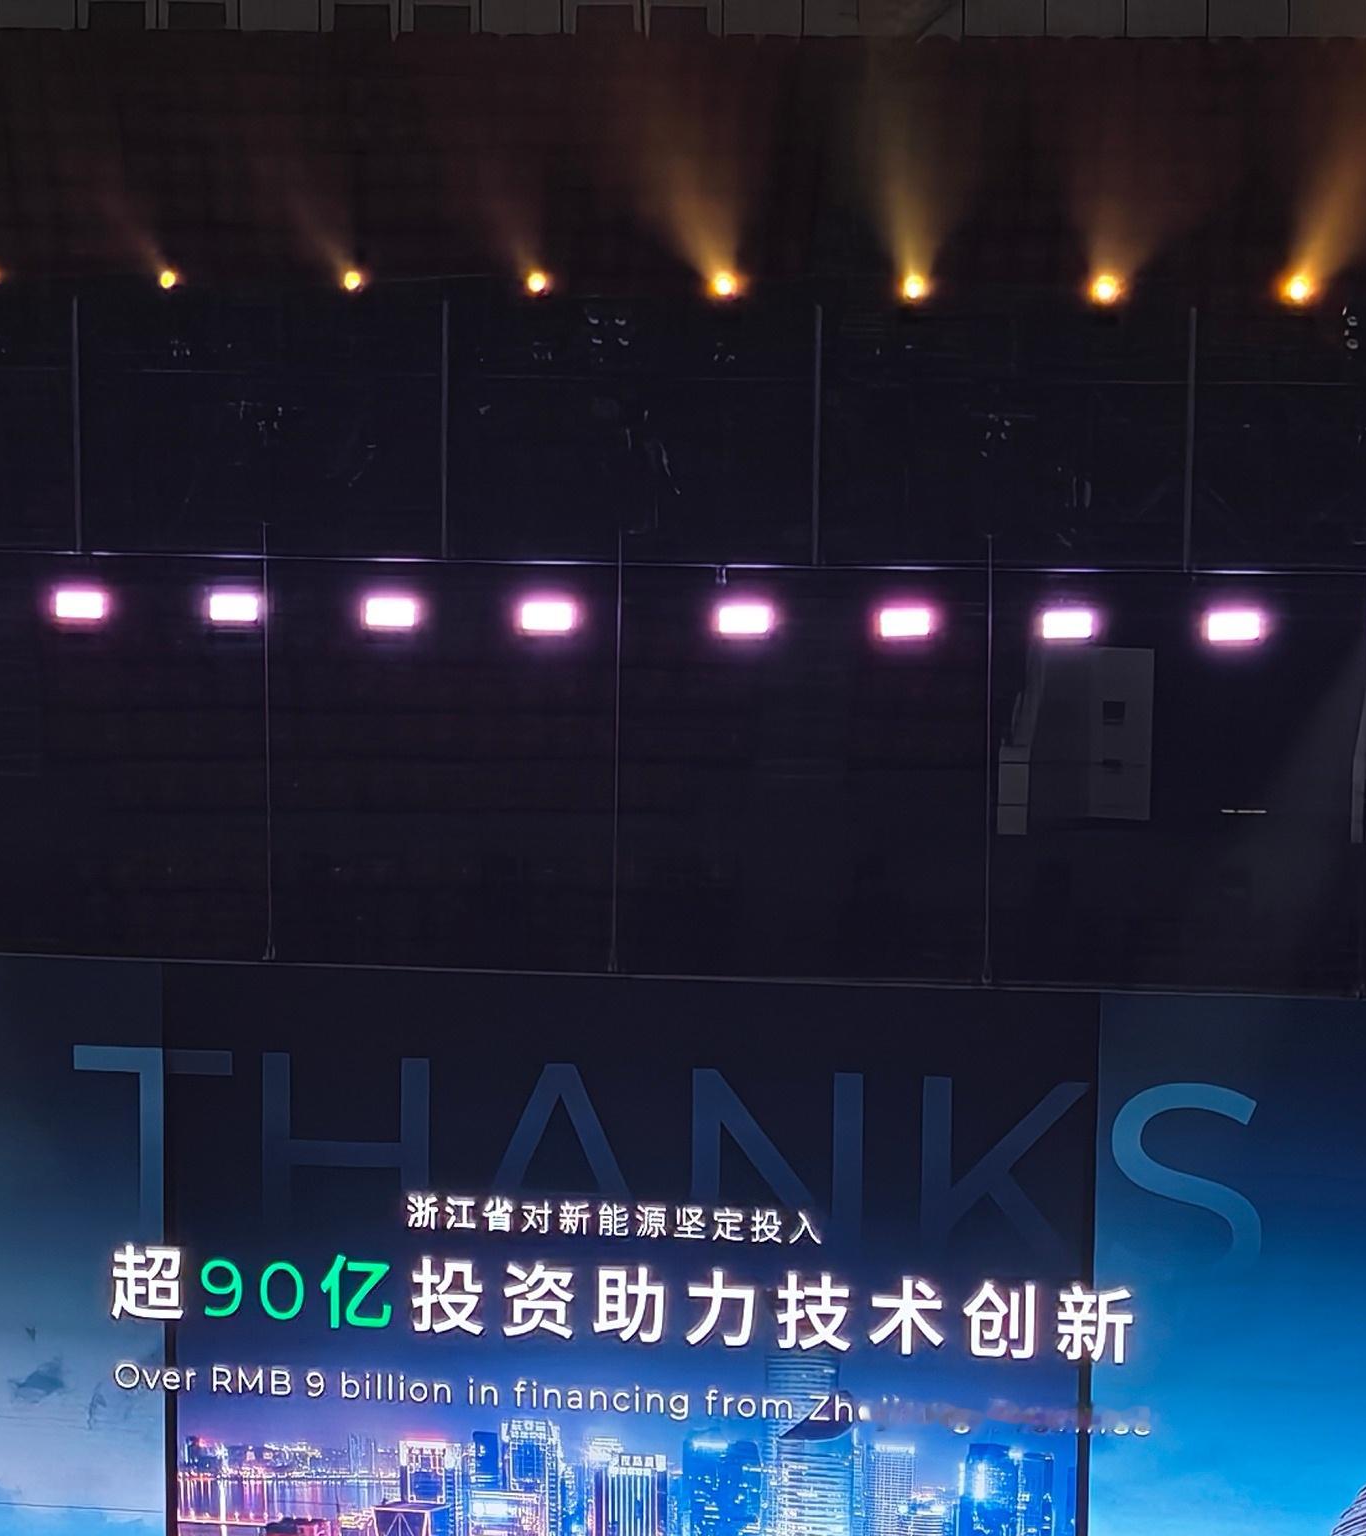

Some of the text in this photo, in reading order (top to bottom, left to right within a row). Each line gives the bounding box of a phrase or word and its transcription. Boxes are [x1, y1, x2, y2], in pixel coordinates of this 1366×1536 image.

[73, 1043, 1263, 1268] THANKS
[407, 1195, 824, 1246] 浙江省对新能源坚定投入
[110, 1243, 1135, 1364] 超90亿投资助力技术创新
[114, 1362, 197, 1391] Over
[211, 1366, 292, 1397] RMB
[306, 1371, 326, 1398] 9
[340, 1371, 452, 1404] billion
[467, 1375, 499, 1407] in
[513, 1379, 690, 1420] financing
[705, 1388, 793, 1421] from
